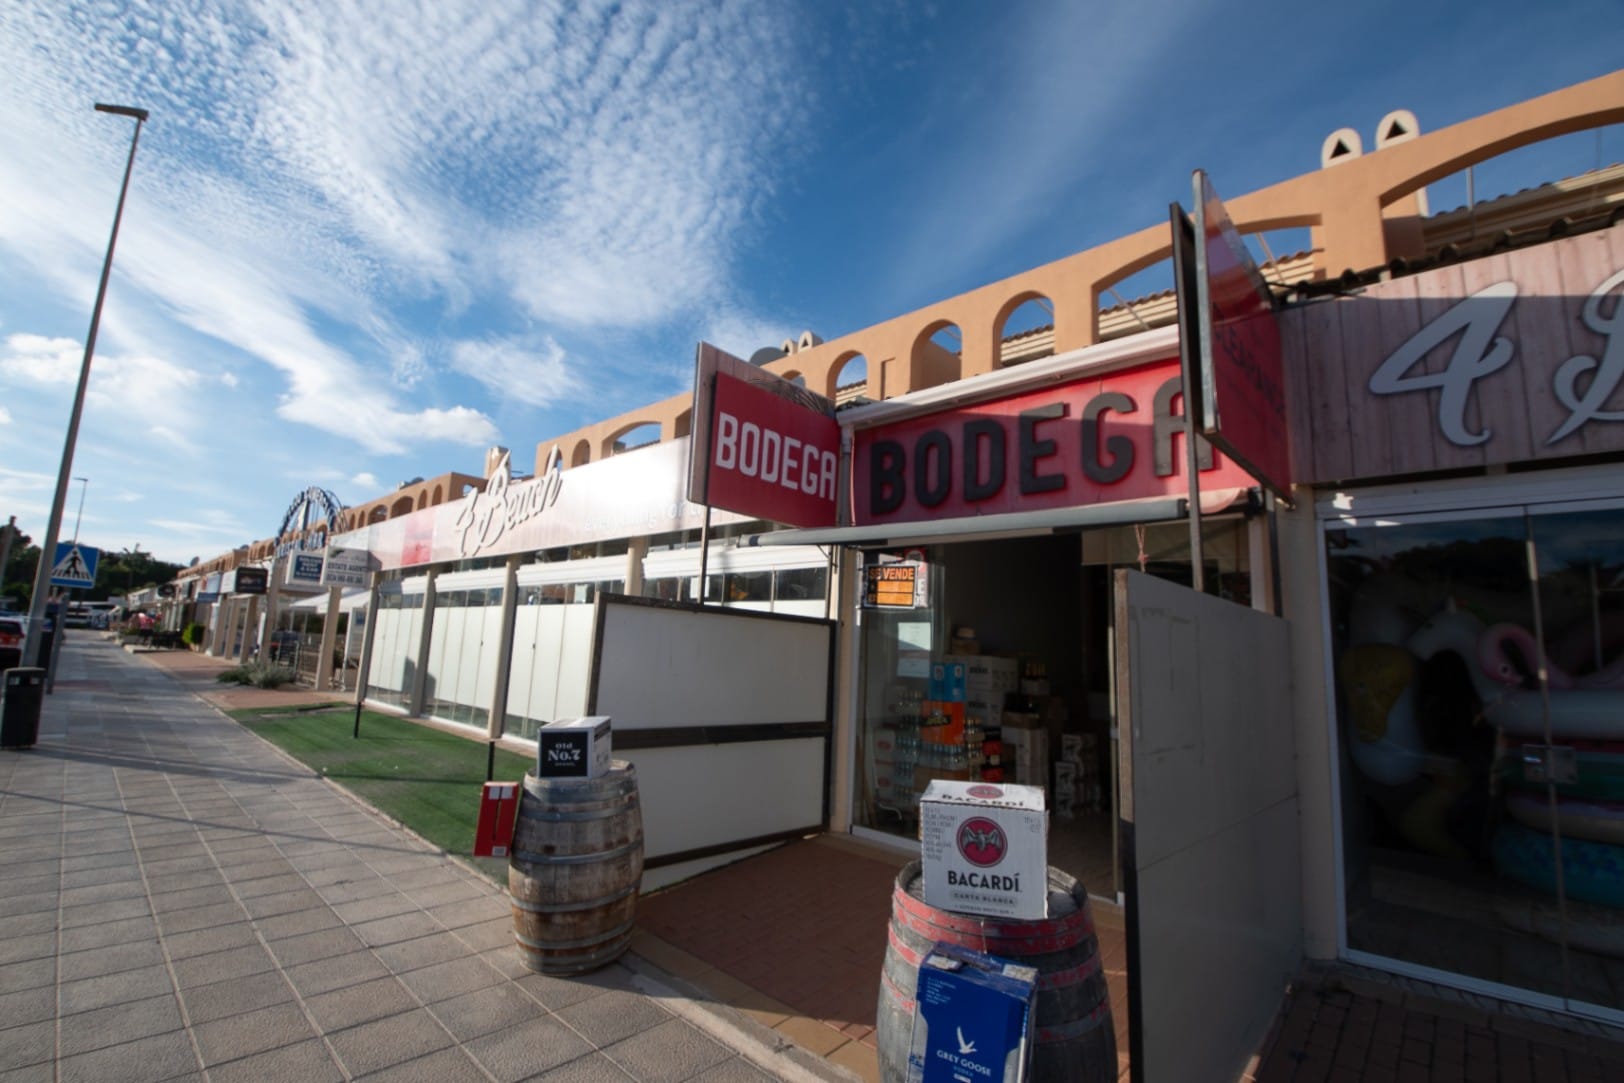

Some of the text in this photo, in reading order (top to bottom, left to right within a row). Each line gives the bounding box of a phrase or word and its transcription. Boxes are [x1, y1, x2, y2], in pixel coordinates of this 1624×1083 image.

[1369, 281, 1518, 446] 4
[716, 411, 837, 501] BODEGA
[870, 375, 1214, 516] BODEGA
[882, 567, 915, 580] VENDE
[548, 749, 581, 761] No.7
[947, 870, 1021, 892] BACARDÍ
[936, 1049, 960, 1064] GREY
[960, 1058, 991, 1076] GOOSE
